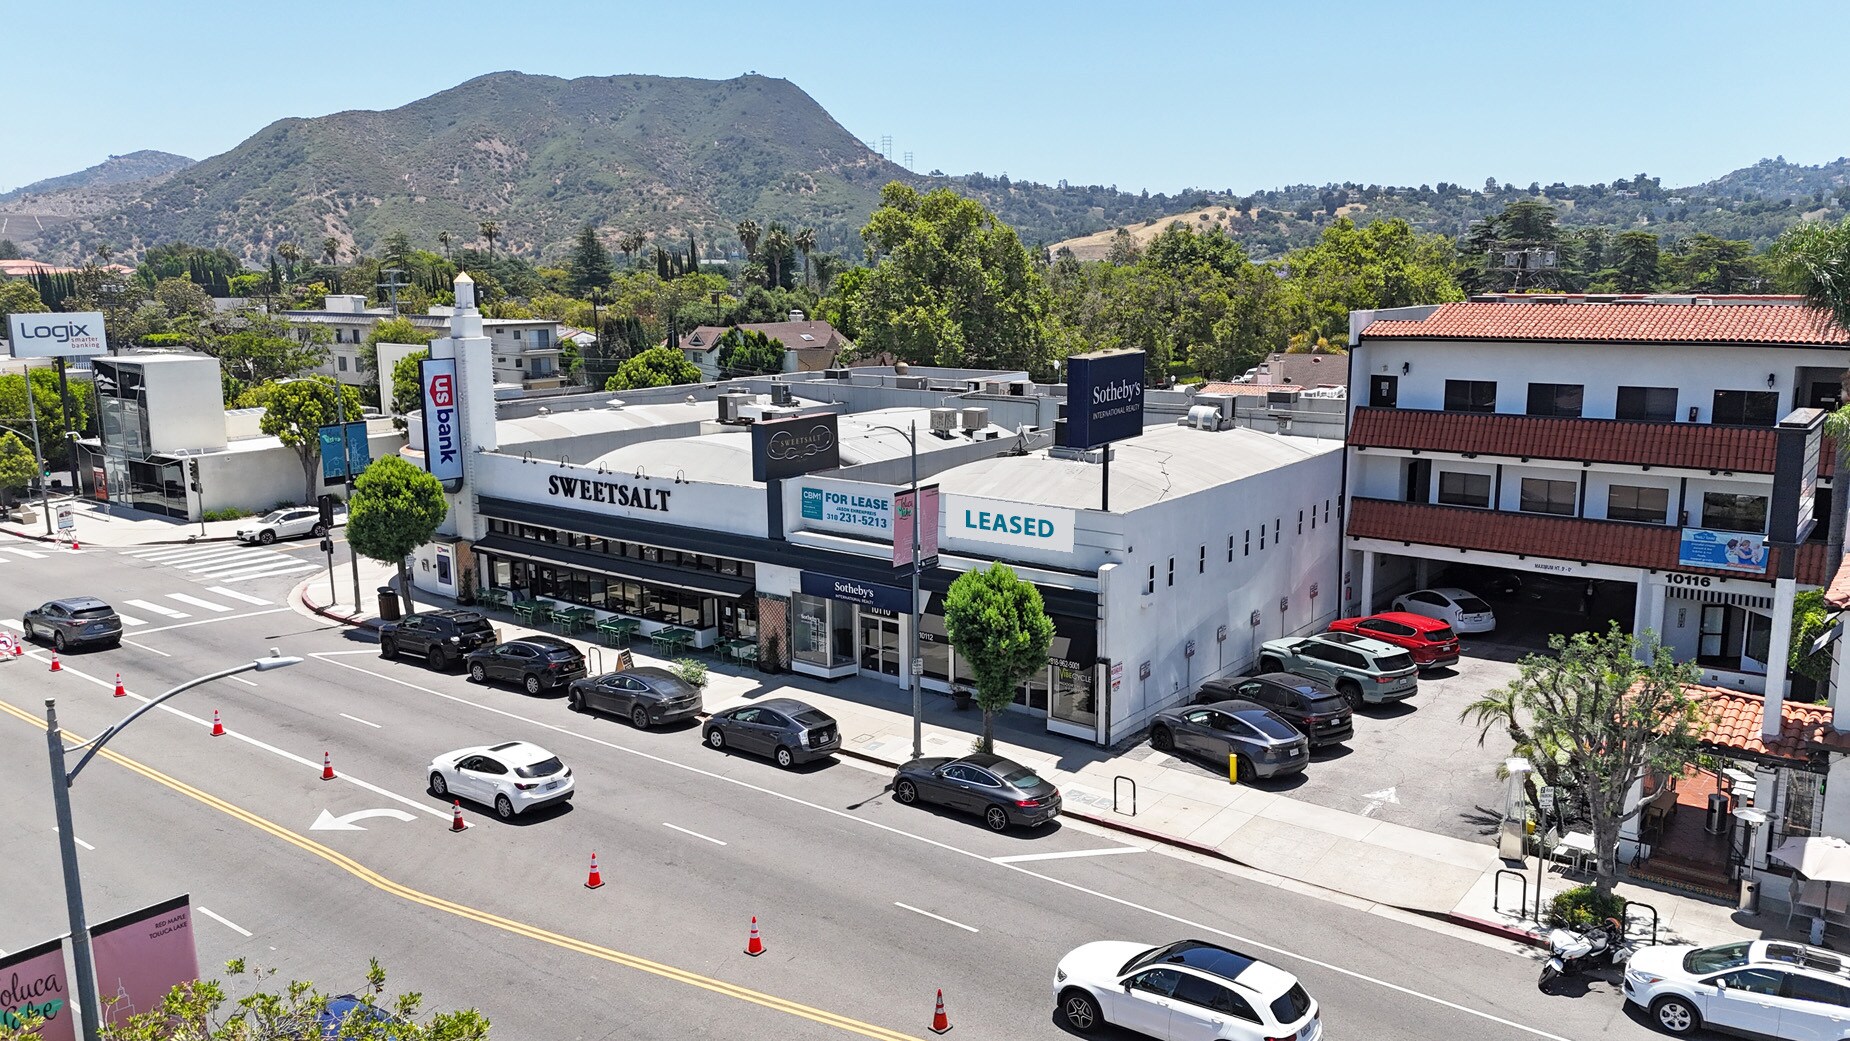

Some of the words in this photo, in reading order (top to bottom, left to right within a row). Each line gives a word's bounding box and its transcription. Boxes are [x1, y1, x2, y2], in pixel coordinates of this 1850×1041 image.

[21, 321, 89, 343] Logix
[435, 377, 449, 408] us
[1093, 379, 1141, 405] Sotheby's
[1093, 406, 1126, 420] INTERNATIONAL
[1125, 403, 1140, 413] REALTY
[436, 408, 457, 465] bank
[780, 434, 821, 447] SWEETSALT
[548, 474, 671, 512] SWEETSALT
[803, 490, 822, 501] CBM1
[825, 492, 848, 505] FOR
[851, 495, 889, 511] LEASE
[839, 512, 887, 529] 231-5213
[965, 509, 1055, 538] LEASED
[834, 581, 874, 598] Sotheby's
[1665, 573, 1711, 588] 10116
[835, 594, 861, 603] INTERNATIONAL
[149, 926, 173, 940] TOLUCA
[172, 921, 188, 932] LAKE
[155, 920, 167, 929] RED
[167, 913, 187, 926] MAPLE
[0, 972, 63, 1007] oluca
